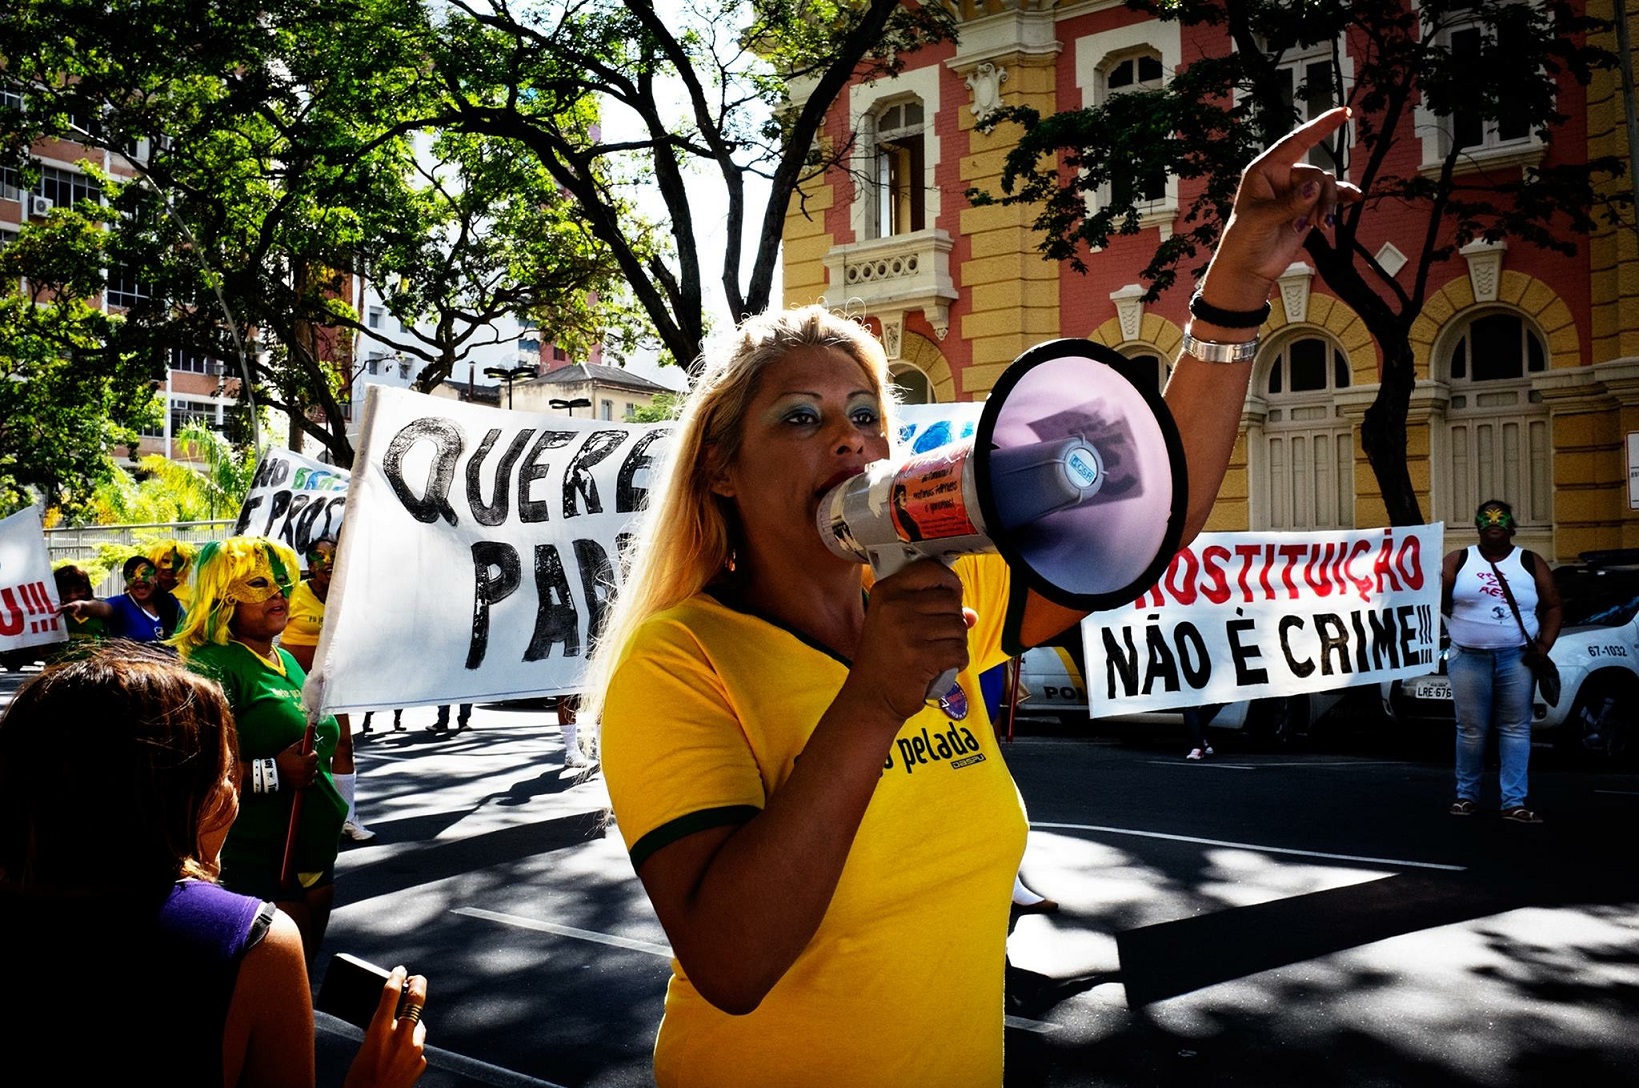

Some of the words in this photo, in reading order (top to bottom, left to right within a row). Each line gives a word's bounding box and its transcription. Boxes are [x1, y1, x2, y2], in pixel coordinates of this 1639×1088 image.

[383, 416, 670, 527] QUERE
[1101, 614, 1212, 699] NÃO
[1587, 645, 1628, 657] 67-1032
[896, 721, 980, 774] pelada
